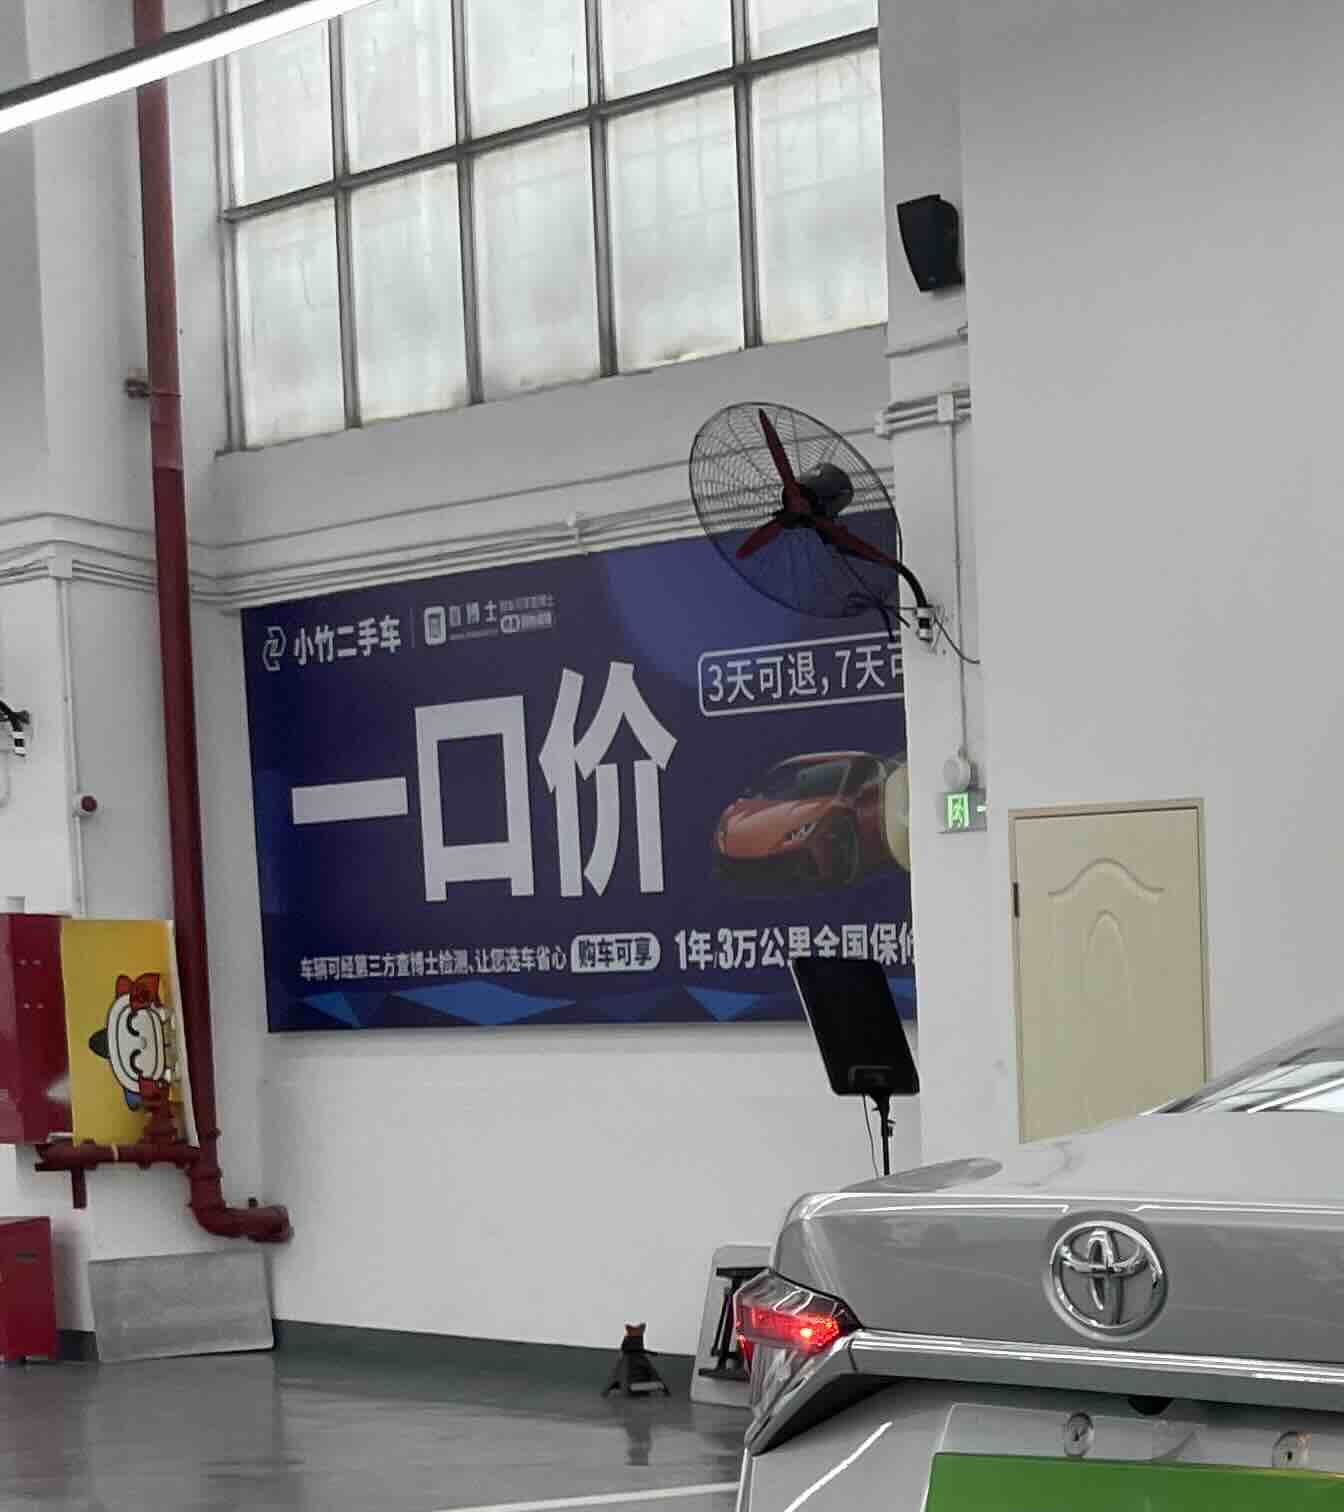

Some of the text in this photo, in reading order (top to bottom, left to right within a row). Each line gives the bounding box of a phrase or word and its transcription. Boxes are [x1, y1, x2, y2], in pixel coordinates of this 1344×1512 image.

[293, 614, 402, 666] 小竹二手车
[291, 660, 678, 902] 一口价
[578, 937, 652, 970] 购车可享
